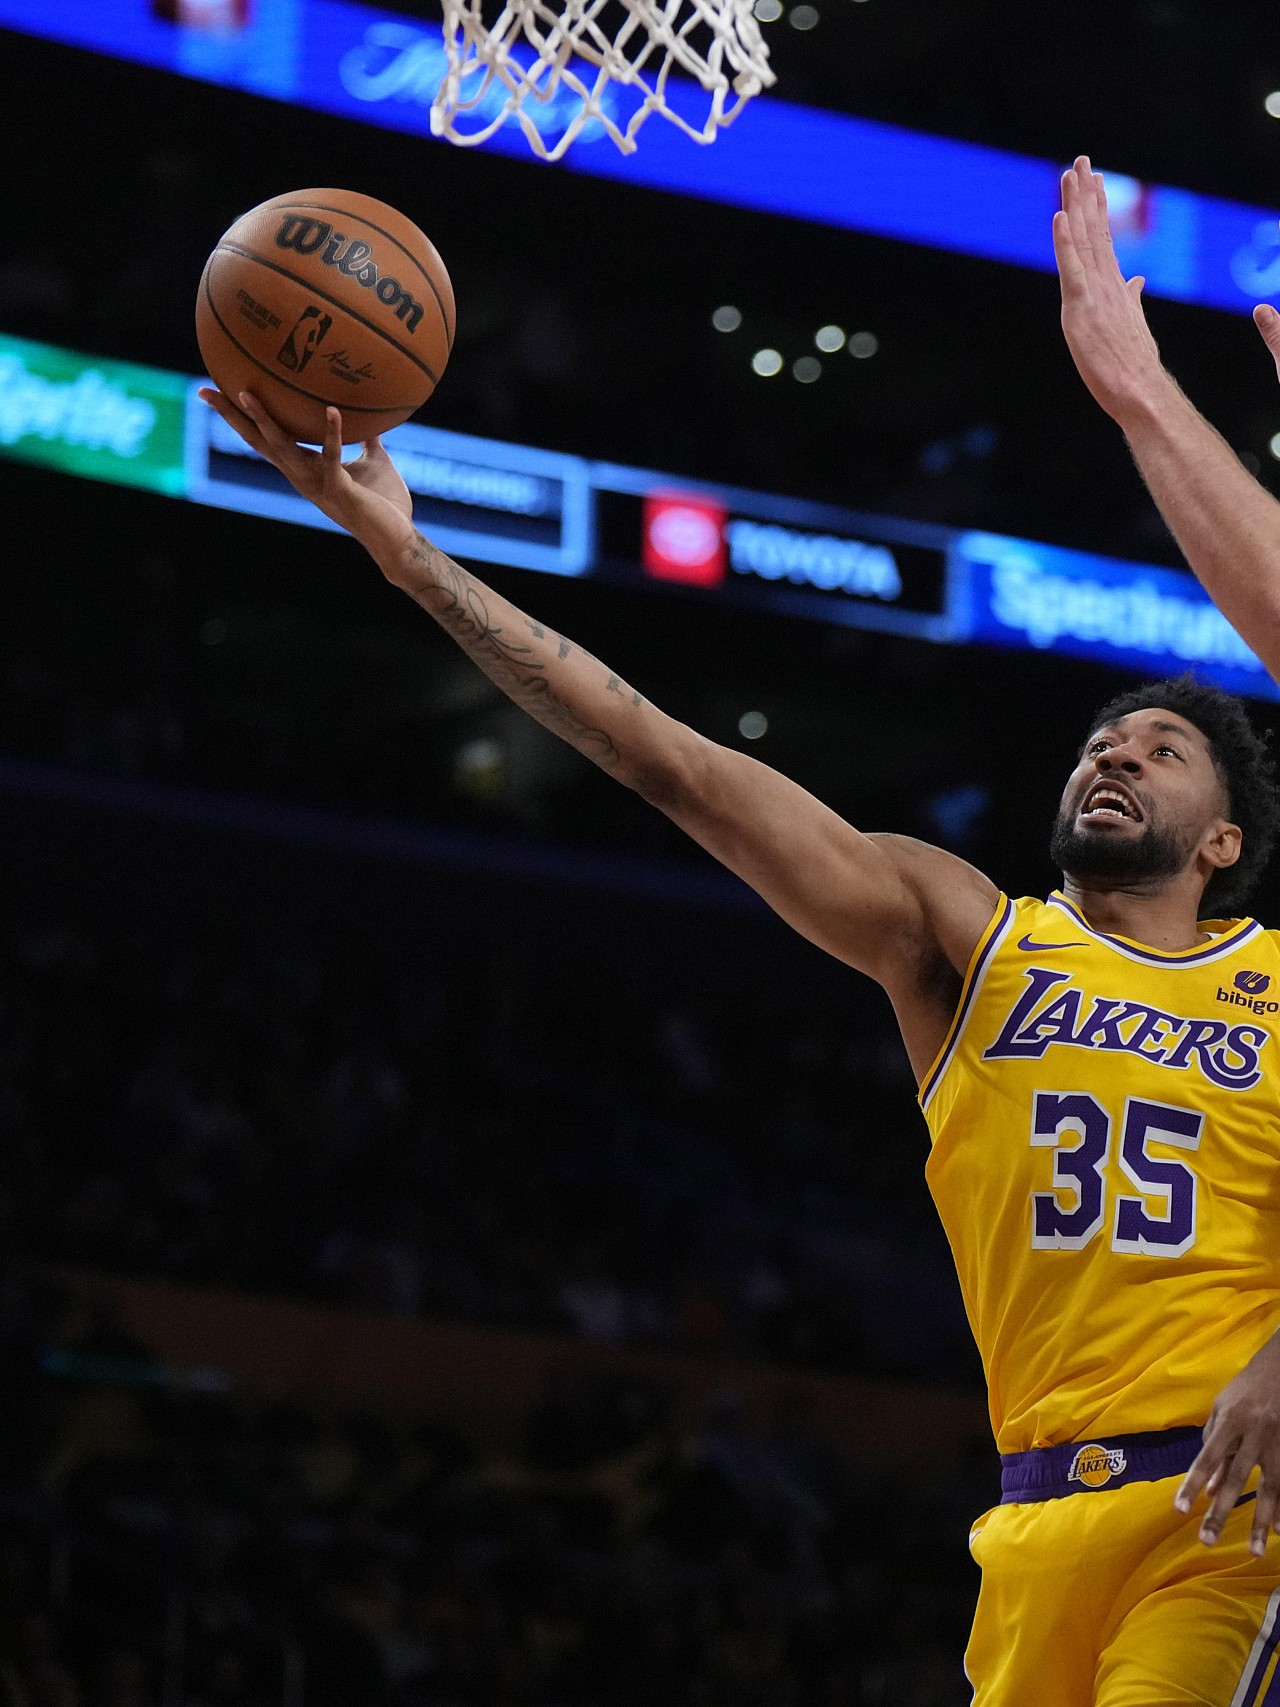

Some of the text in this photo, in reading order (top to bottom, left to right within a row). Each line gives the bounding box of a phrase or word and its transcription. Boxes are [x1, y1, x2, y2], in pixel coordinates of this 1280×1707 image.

[274, 213, 424, 335] Wilson
[726, 519, 901, 600] TOYOTA
[981, 966, 1272, 1092] LAKERS
[1216, 987, 1279, 1015] bibigo
[1029, 1090, 1206, 1258] 35
[1072, 1456, 1125, 1478] LAKERS
